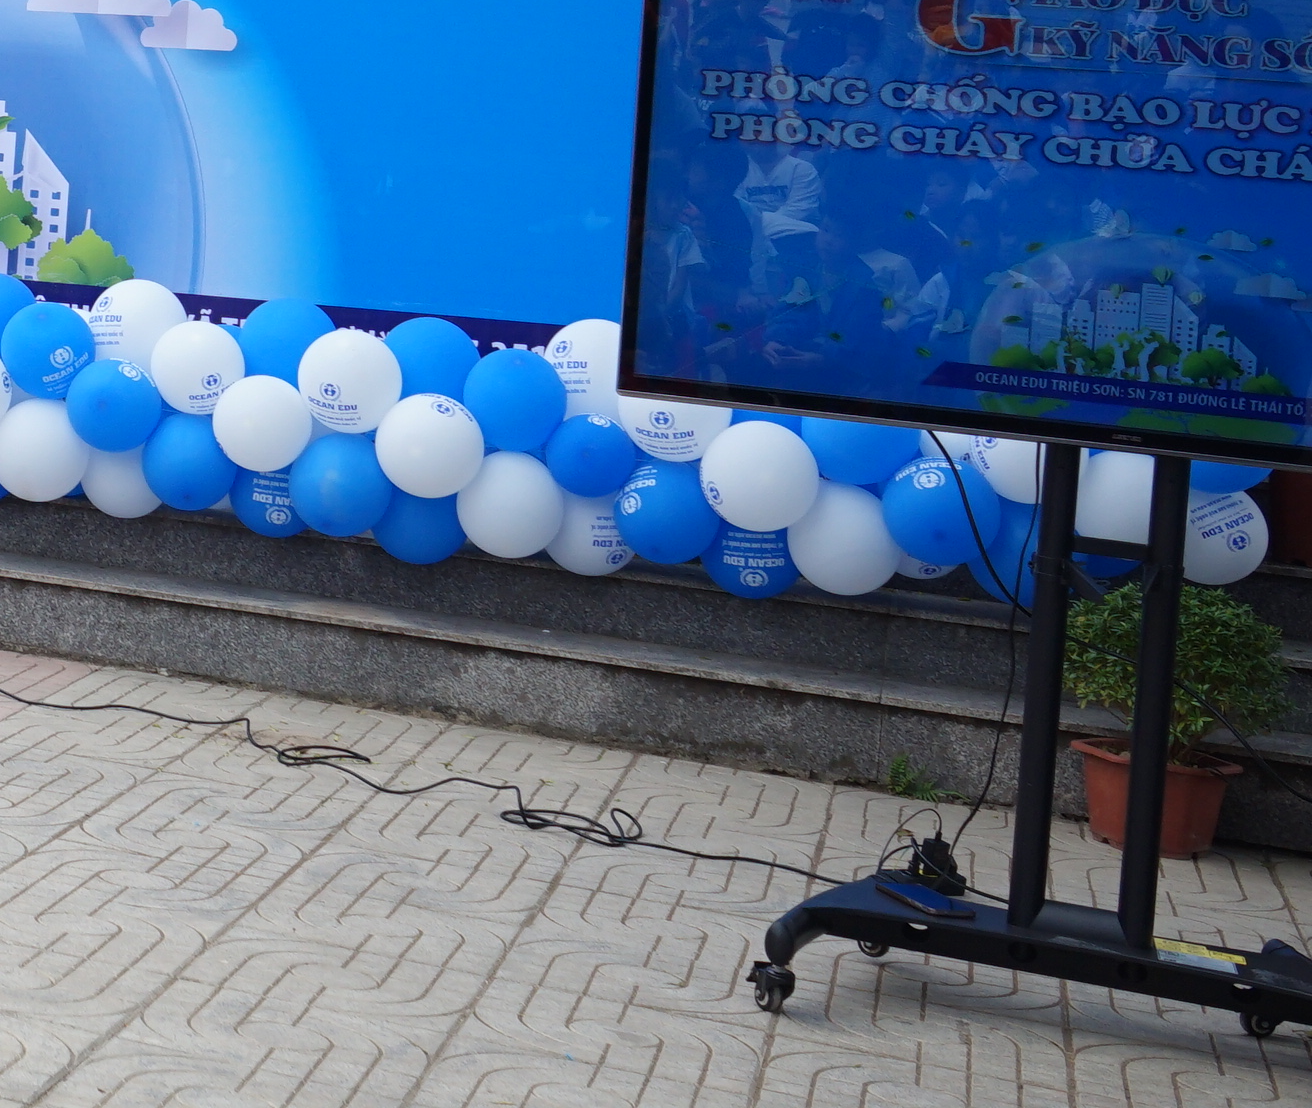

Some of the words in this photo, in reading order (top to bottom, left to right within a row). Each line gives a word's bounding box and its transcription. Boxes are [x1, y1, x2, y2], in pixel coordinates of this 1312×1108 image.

[1031, 20, 1097, 60] KỸ
[1106, 25, 1250, 70] NĂNG
[702, 67, 872, 105] PHÒNG
[879, 73, 1059, 118] CHỐNG
[1068, 91, 1180, 127] BẠO
[1191, 98, 1302, 141] LỰC
[710, 111, 879, 149] PHÒNG
[888, 124, 1036, 161] CHÁY
[1044, 131, 1194, 175] CHỮA
[566, 360, 588, 370] EDU
[42, 366, 75, 383] OCEAN
[188, 390, 219, 401] OCEAN
[975, 371, 1018, 387] OCEAN
[1021, 376, 1048, 389] EDU
[1051, 379, 1090, 396] TRIỆU
[1092, 383, 1126, 397] SƠN:
[1127, 387, 1145, 399] SN
[1149, 389, 1173, 403] 781
[1178, 391, 1227, 409] ĐƯỜNG
[1230, 395, 1246, 410] LÊ
[1250, 398, 1282, 414] THÁI
[308, 395, 336, 412] OCEAN
[337, 403, 358, 412] EDU
[635, 427, 670, 440] OCEAN
[672, 429, 695, 440] EDU
[251, 491, 272, 504] EDU
[1223, 511, 1254, 530] OCEAN
[1200, 525, 1222, 539] EDU
[592, 538, 611, 547] EDU
[723, 554, 744, 566] EDU
[747, 557, 784, 566] OCEAN
